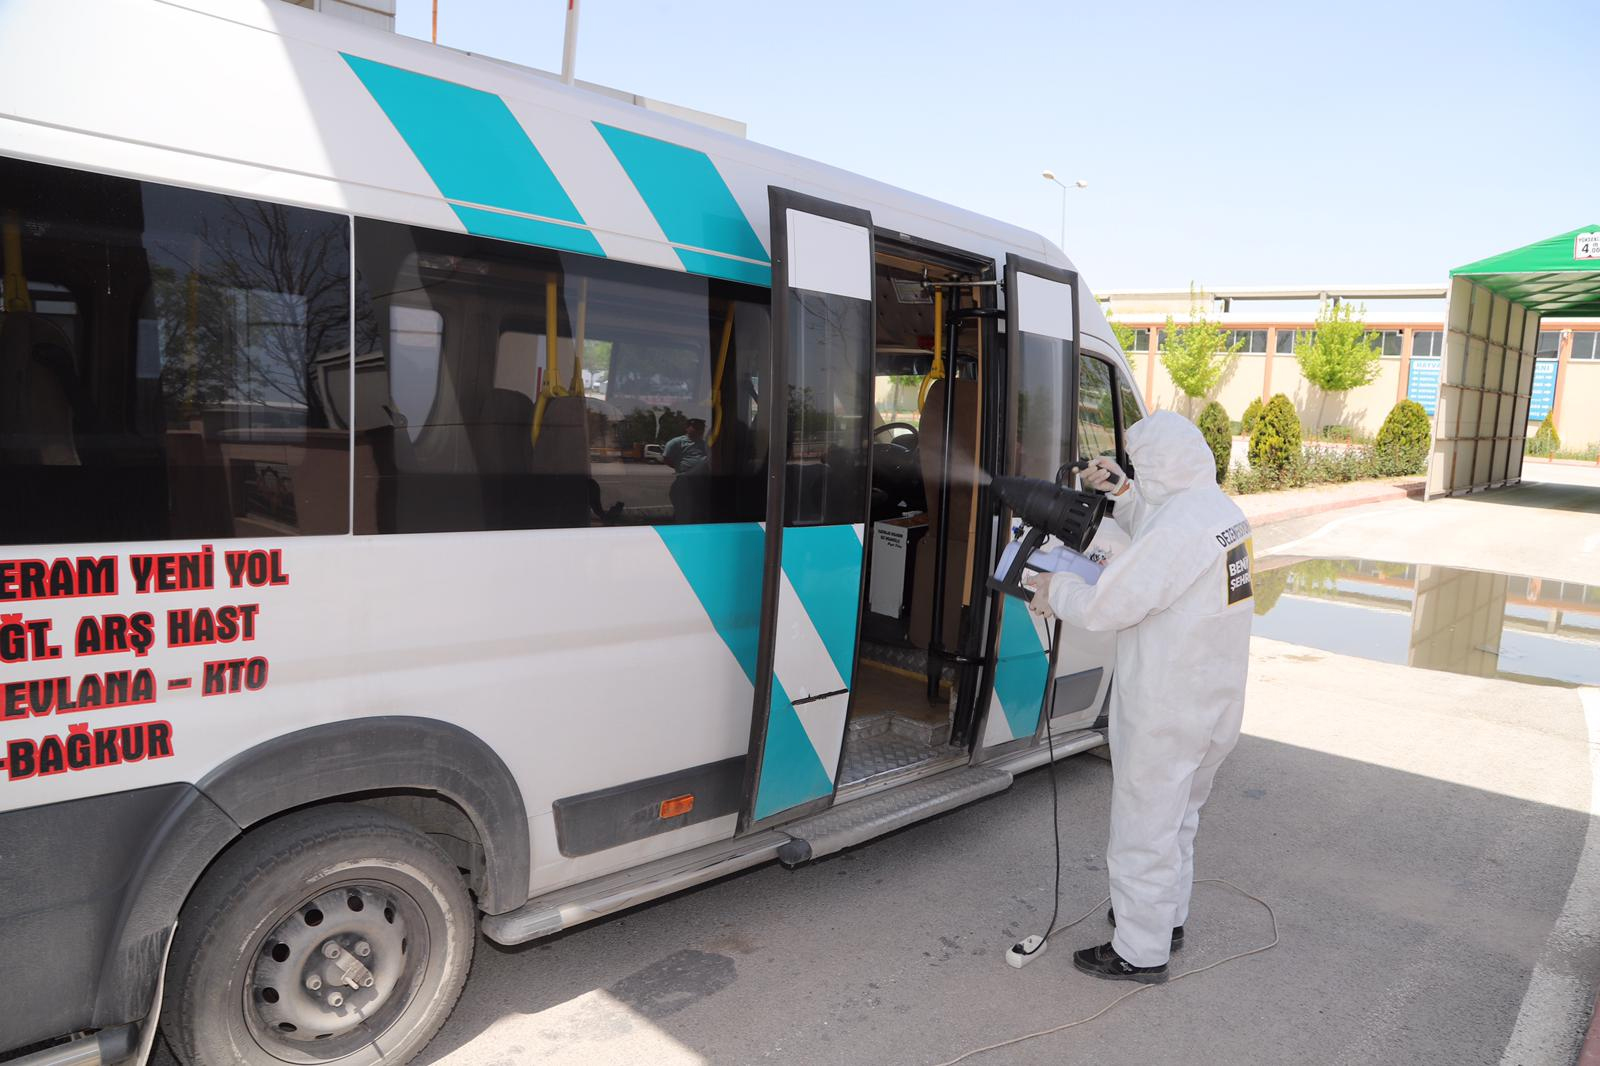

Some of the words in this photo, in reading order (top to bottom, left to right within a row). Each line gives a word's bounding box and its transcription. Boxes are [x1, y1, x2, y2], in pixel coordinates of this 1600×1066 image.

[0, 555, 118, 602] ERAM
[130, 544, 214, 594] YENİ
[225, 549, 289, 588] YOL
[0, 613, 62, 663] ĞT.
[75, 611, 155, 657] ARŞ
[167, 603, 259, 648] HAST
[0, 668, 156, 721] EVLANA
[202, 656, 268, 696] KTO
